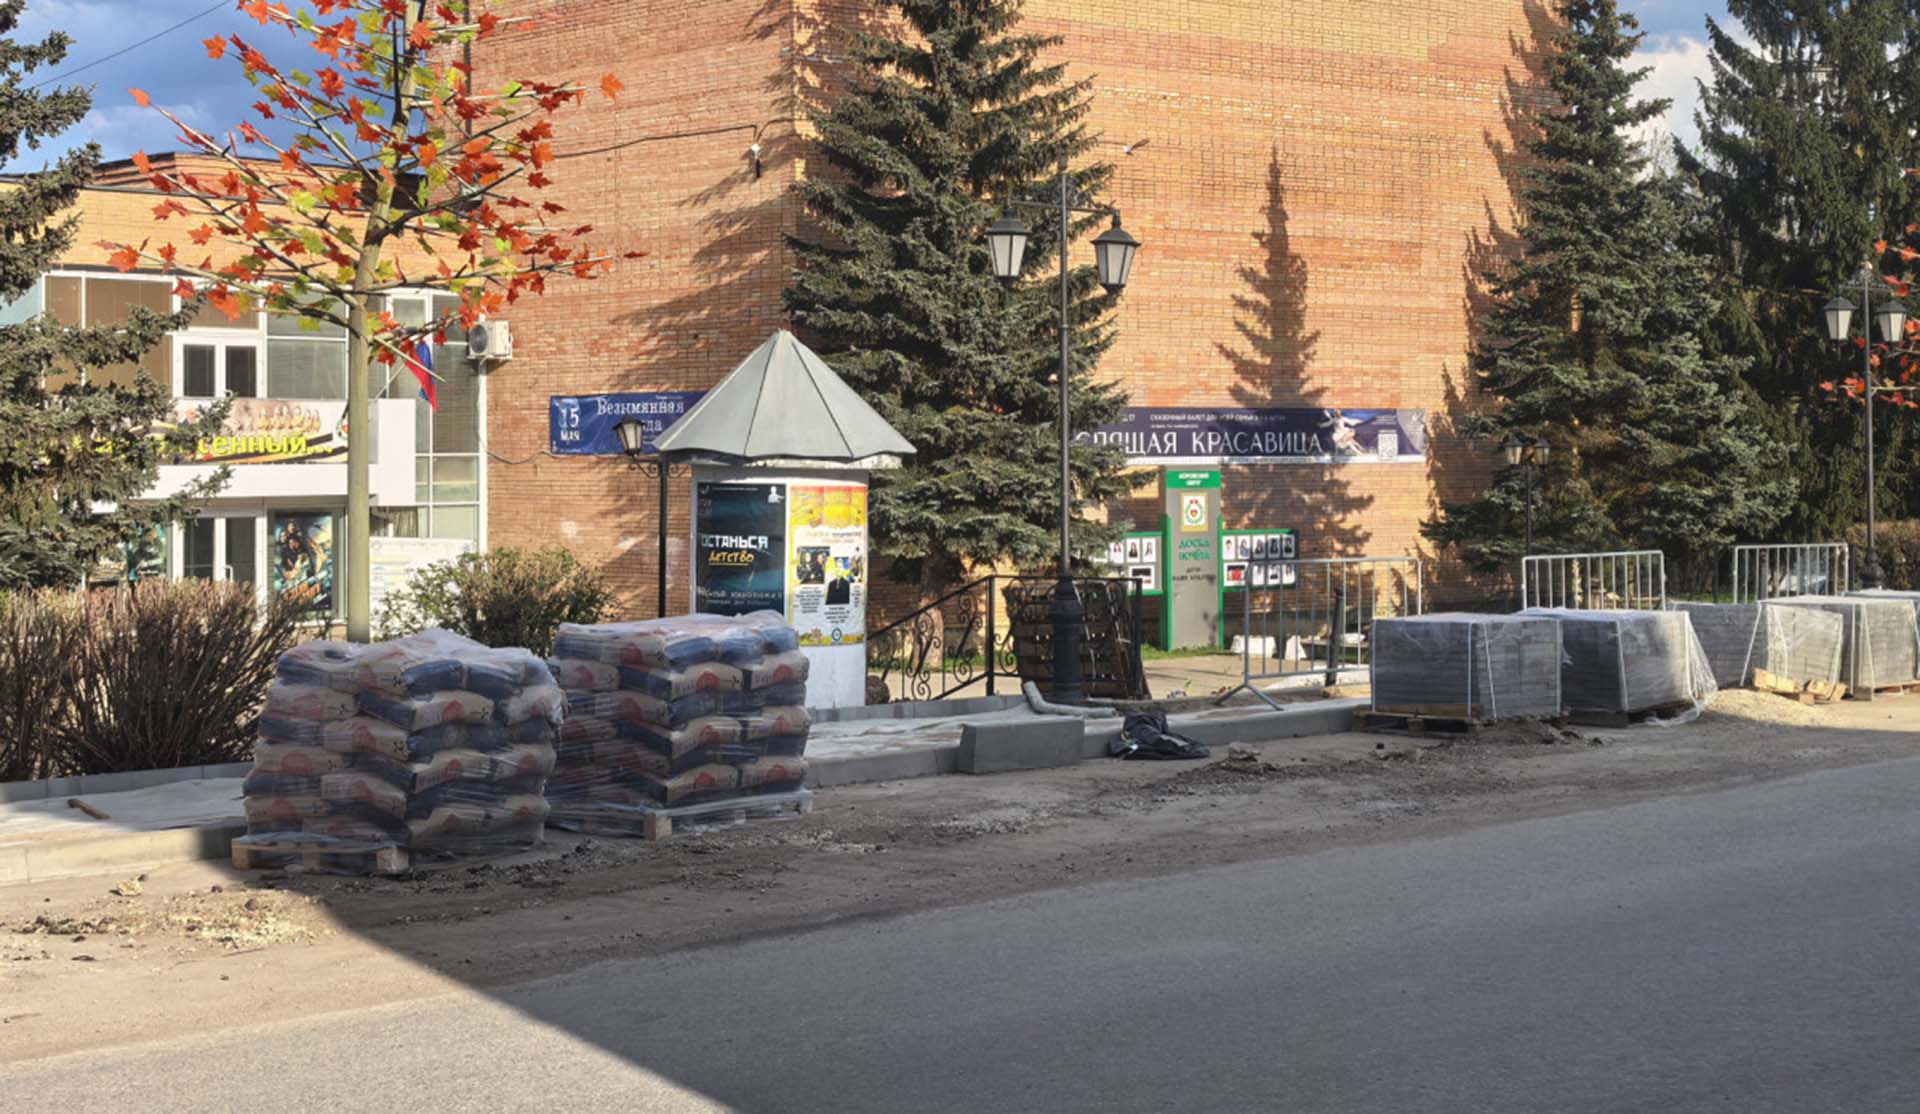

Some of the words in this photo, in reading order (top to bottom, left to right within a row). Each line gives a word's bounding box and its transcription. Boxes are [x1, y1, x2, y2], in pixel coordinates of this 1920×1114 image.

[561, 407, 580, 429] 15
[1191, 431, 1323, 454] КРАСАВИЦА
[701, 534, 769, 549] ОСТАНЬСЯ
